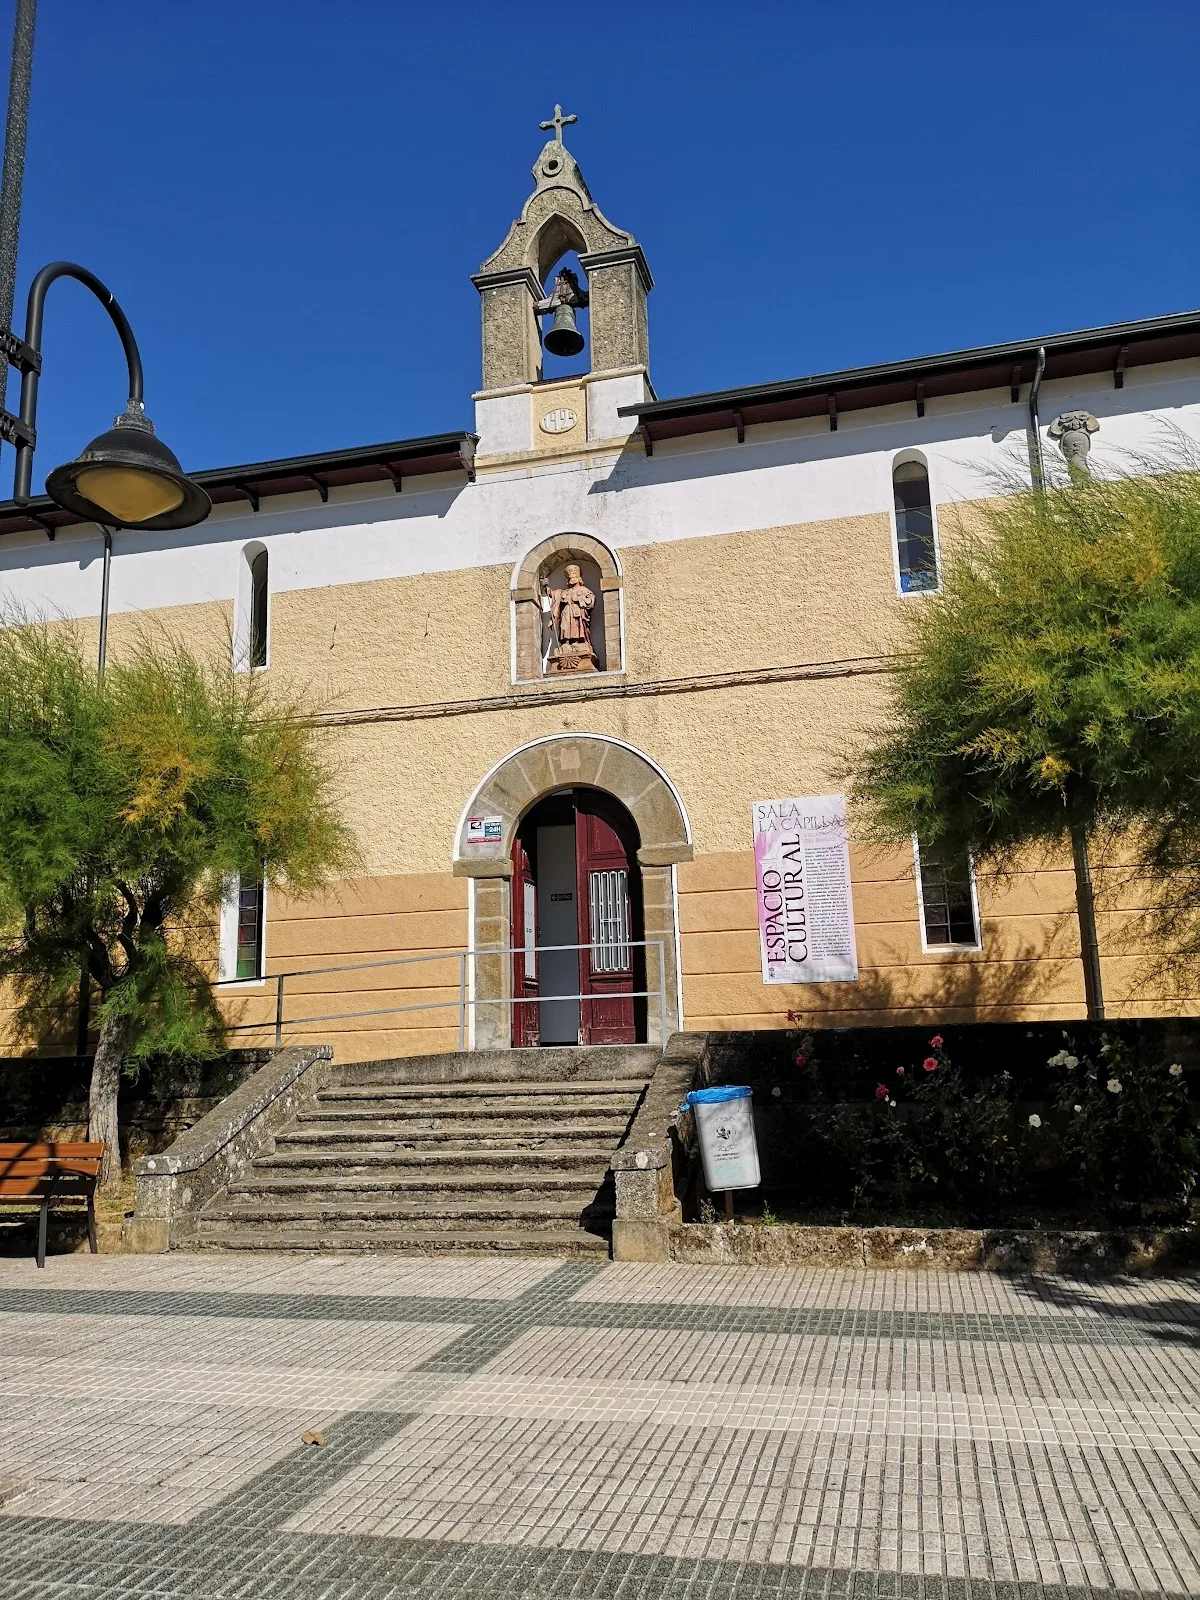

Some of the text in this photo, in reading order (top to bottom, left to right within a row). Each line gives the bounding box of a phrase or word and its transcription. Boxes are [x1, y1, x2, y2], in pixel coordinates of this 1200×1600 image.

[758, 803, 801, 820] SALA
[759, 815, 841, 833] LA CAPILLA
[762, 869, 787, 964] ESPACIO
[781, 833, 808, 963] CULTURAL
